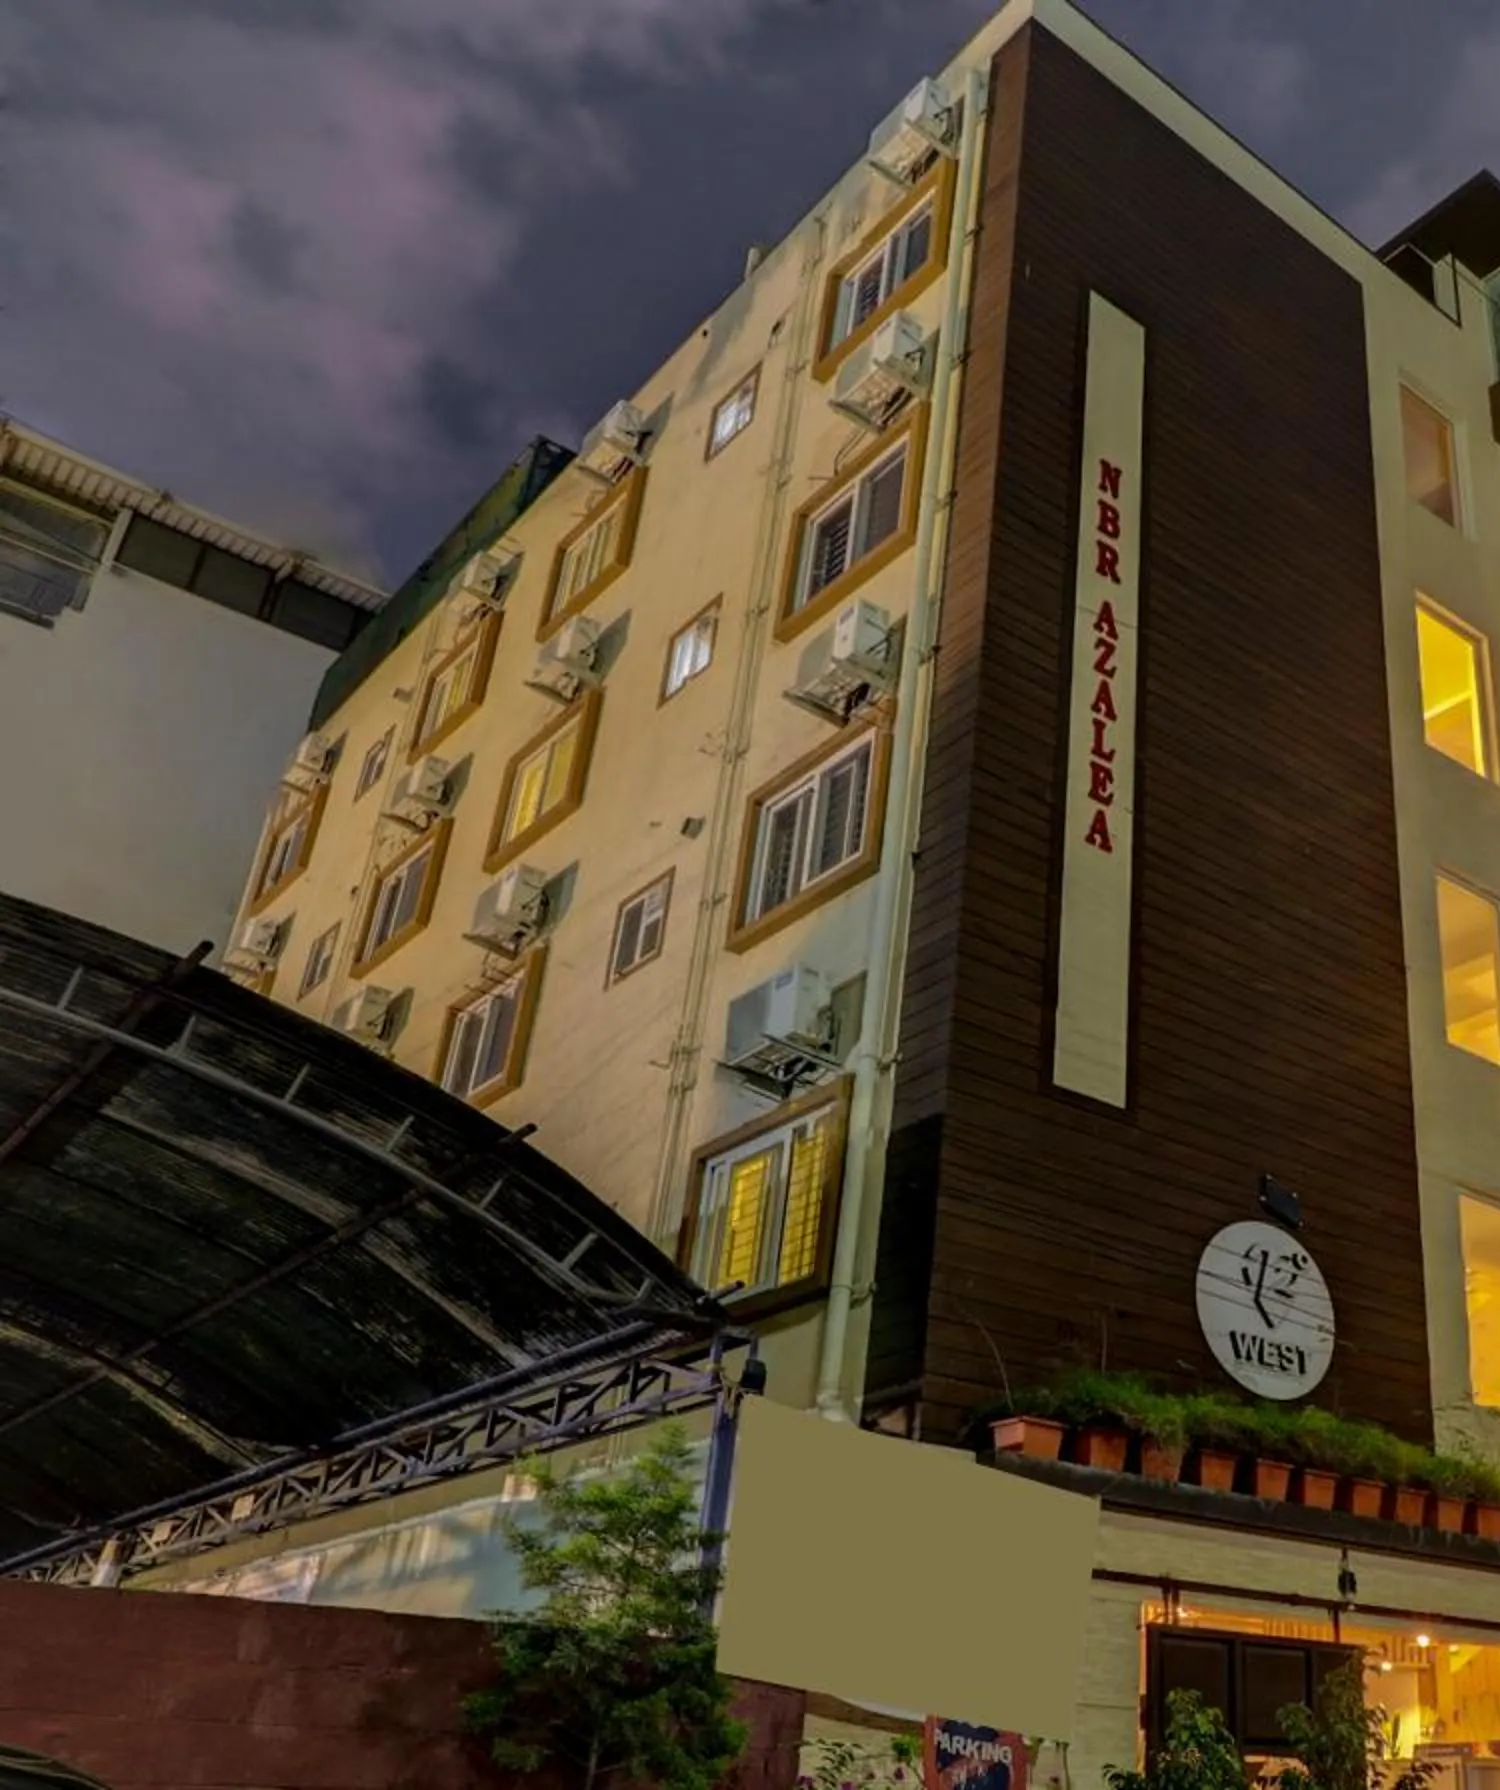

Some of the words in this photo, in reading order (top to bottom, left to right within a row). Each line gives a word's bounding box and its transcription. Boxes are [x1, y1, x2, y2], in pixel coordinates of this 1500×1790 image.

[1095, 458, 1122, 585] NBR
[1084, 600, 1119, 854] AZALEA
[1229, 1329, 1310, 1376] WEST
[933, 1727, 1013, 1765] PARKING
